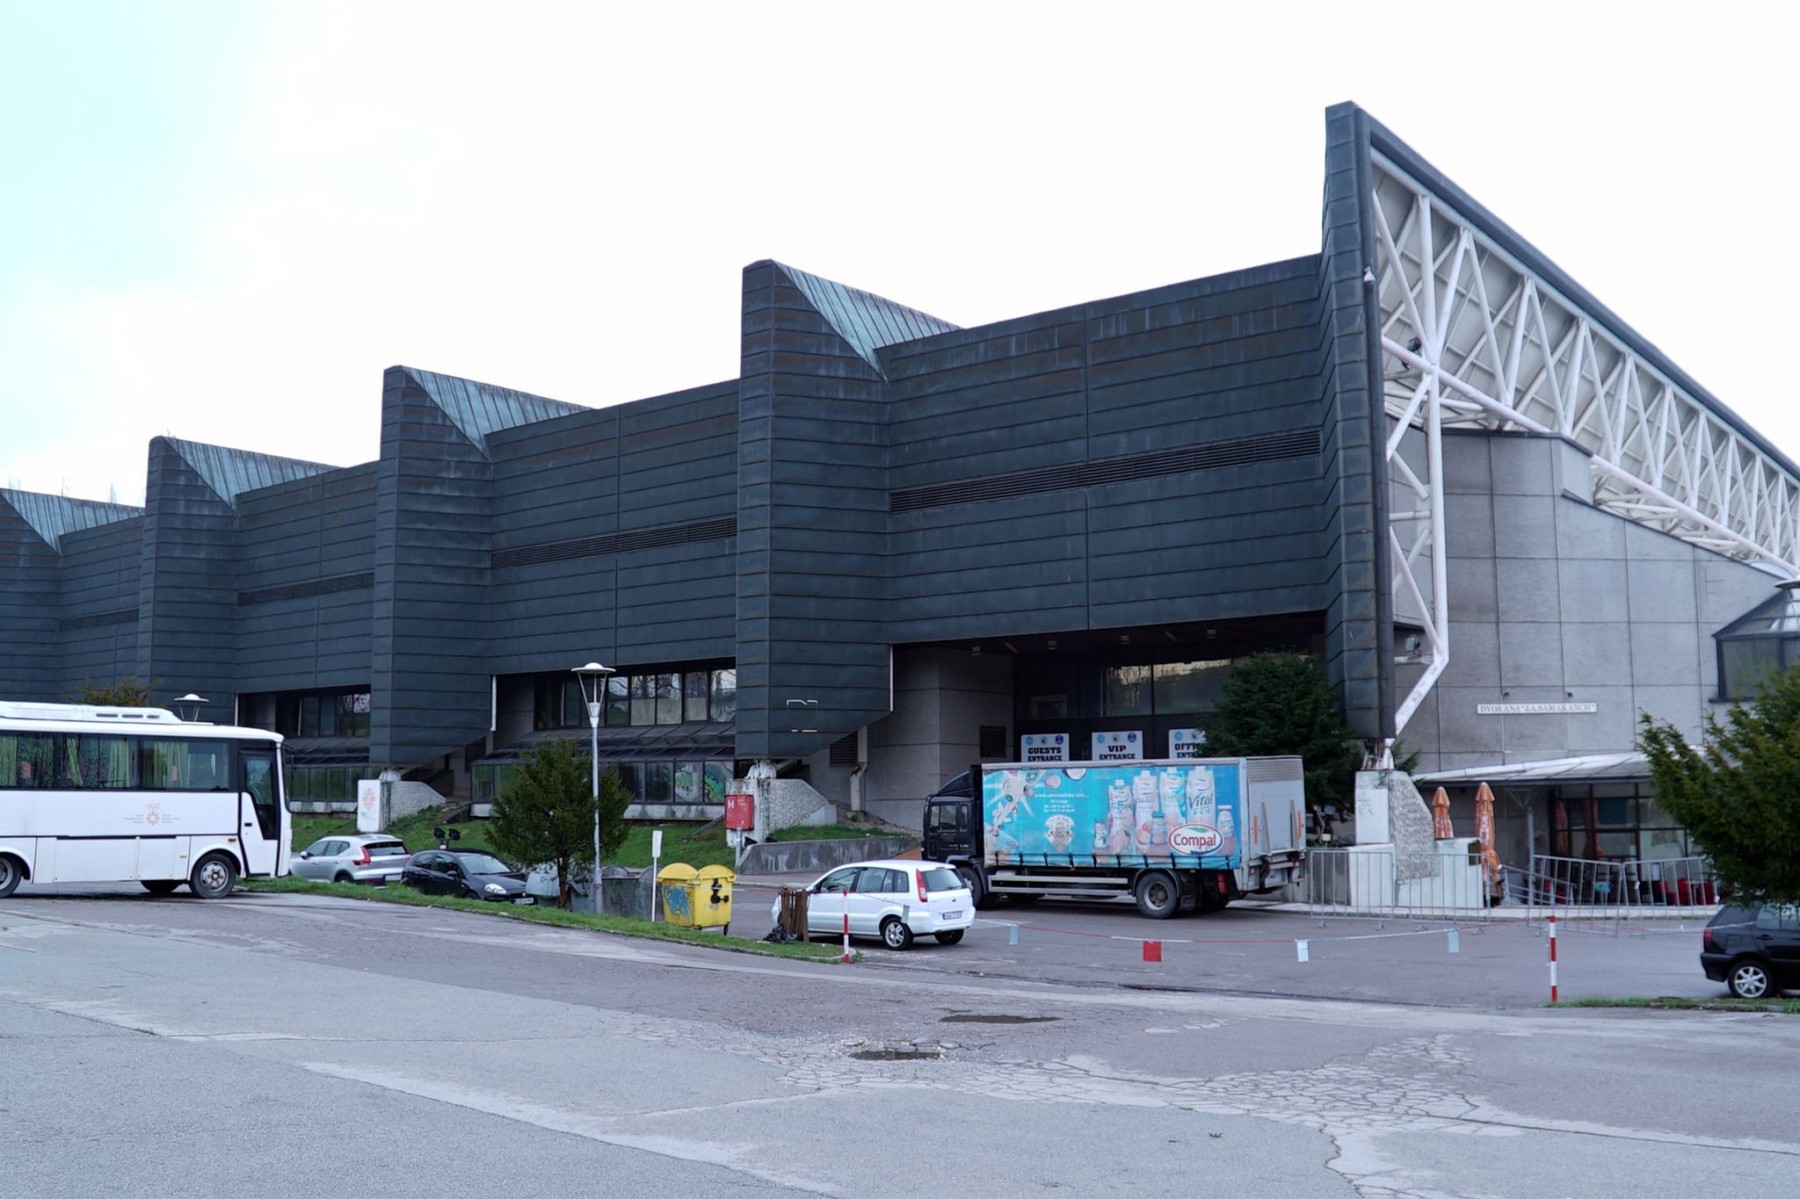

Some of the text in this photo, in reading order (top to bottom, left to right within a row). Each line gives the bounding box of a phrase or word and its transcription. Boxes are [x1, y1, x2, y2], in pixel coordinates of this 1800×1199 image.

[1027, 747, 1062, 755] GUESTS
[1107, 745, 1127, 753] VIP
[1099, 753, 1136, 761] ENTRANCE
[727, 799, 735, 809] H
[1188, 792, 1214, 809] Vital
[1173, 833, 1217, 850] Compal
